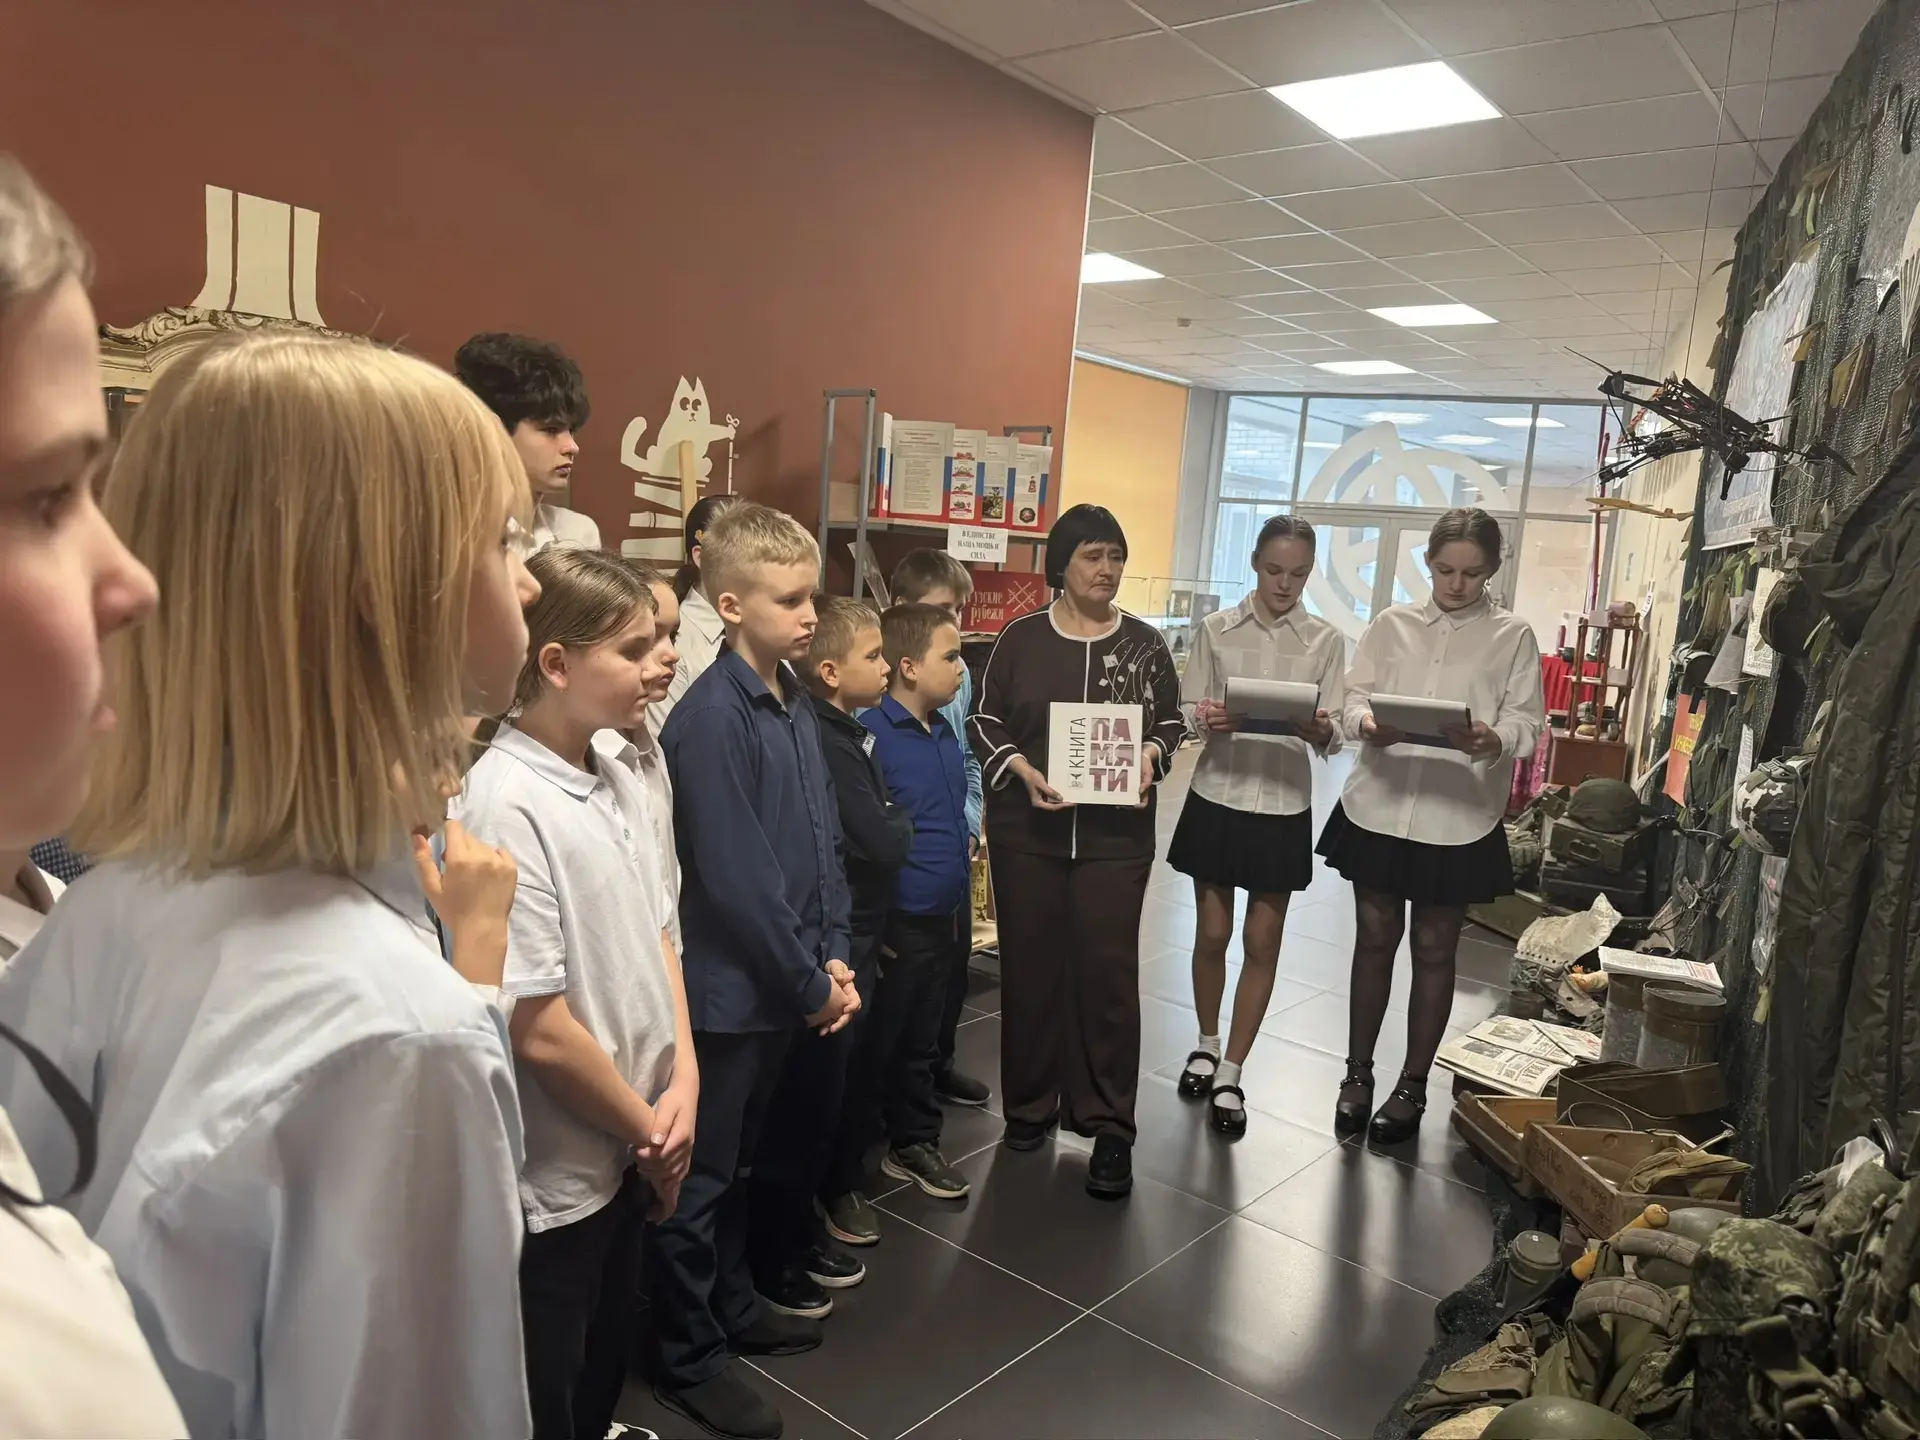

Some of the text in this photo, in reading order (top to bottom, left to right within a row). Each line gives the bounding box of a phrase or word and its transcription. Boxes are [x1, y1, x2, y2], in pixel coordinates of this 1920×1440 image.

[966, 530, 996, 540] ЕДИНСТВЕ
[957, 540, 975, 548] НАША
[976, 541, 994, 550] МОЩЬ
[970, 551, 986, 560] СИЛА
[970, 604, 1005, 626] рубежи
[1068, 717, 1087, 769] КНИГА
